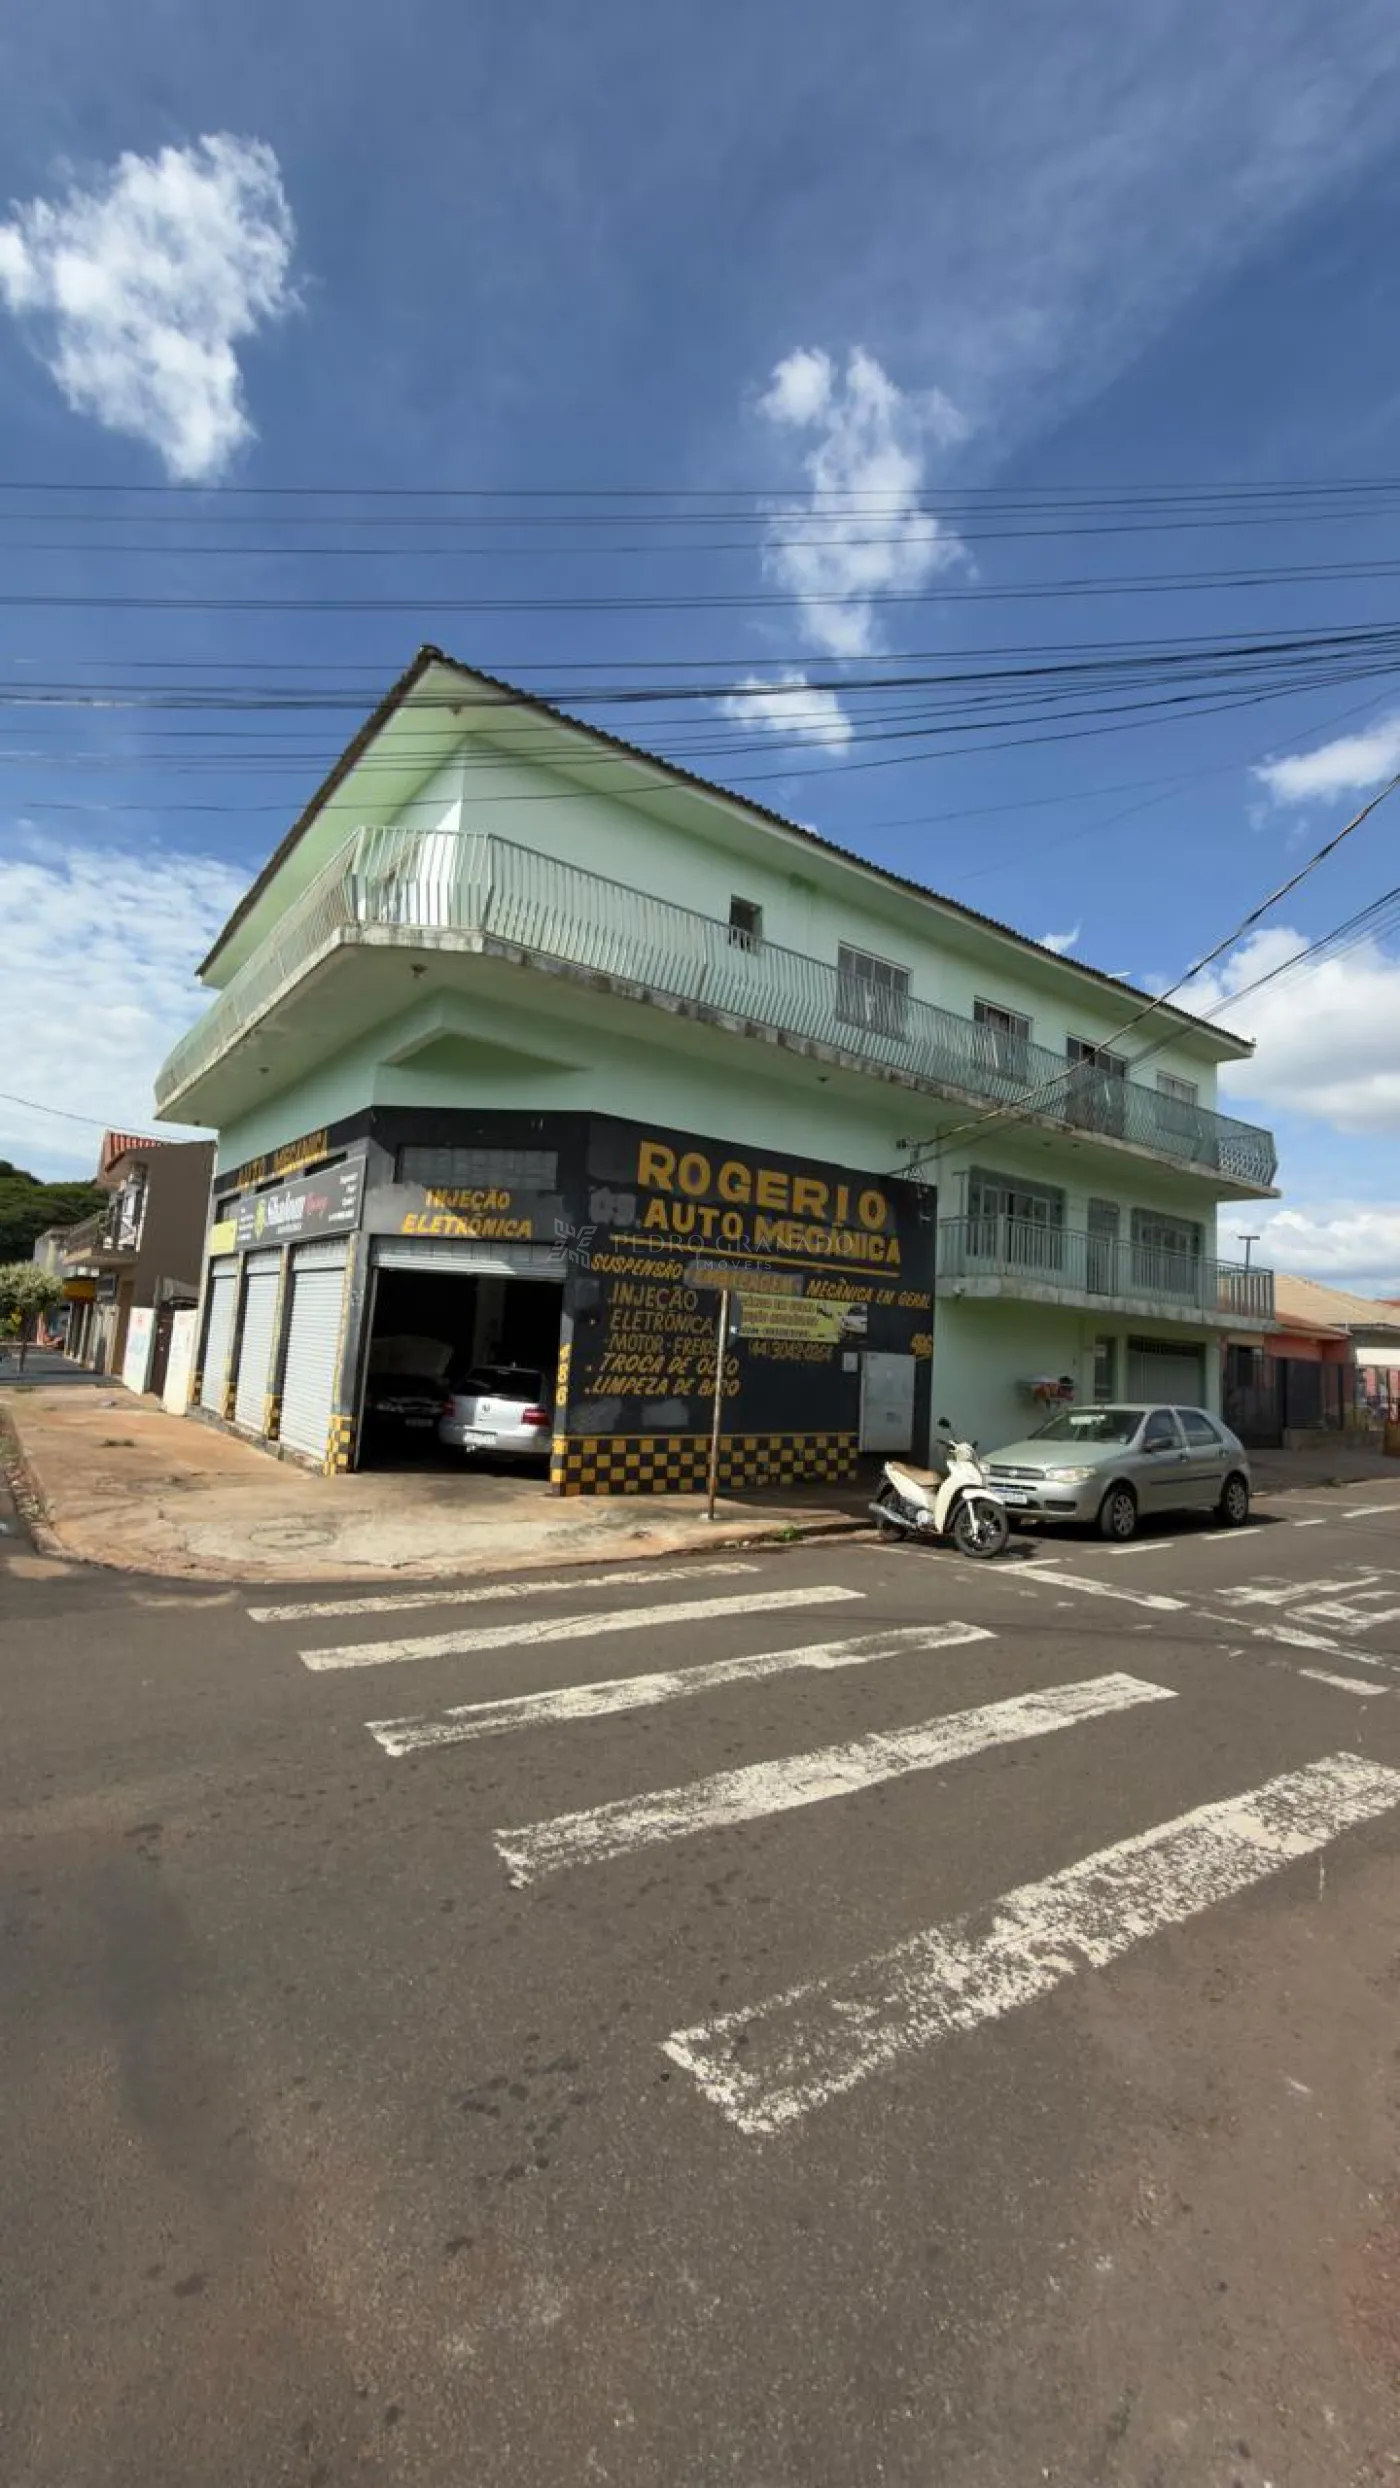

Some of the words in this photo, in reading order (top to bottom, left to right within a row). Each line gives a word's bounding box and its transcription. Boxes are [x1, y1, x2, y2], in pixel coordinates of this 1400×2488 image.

[637, 1140, 888, 1230] ROGERIO
[424, 1187, 511, 1212] INJEÇÃO
[402, 1212, 533, 1238] ELETRÔNICA
[643, 1197, 744, 1241] AUTO
[591, 1253, 684, 1280] SUSPENSÃO
[608, 1333, 664, 1353] MOTOR
[599, 1352, 666, 1374] TROCA
[667, 1356, 692, 1375] DE
[592, 1375, 669, 1395] LIMPEZA
[672, 1377, 696, 1395] DE
